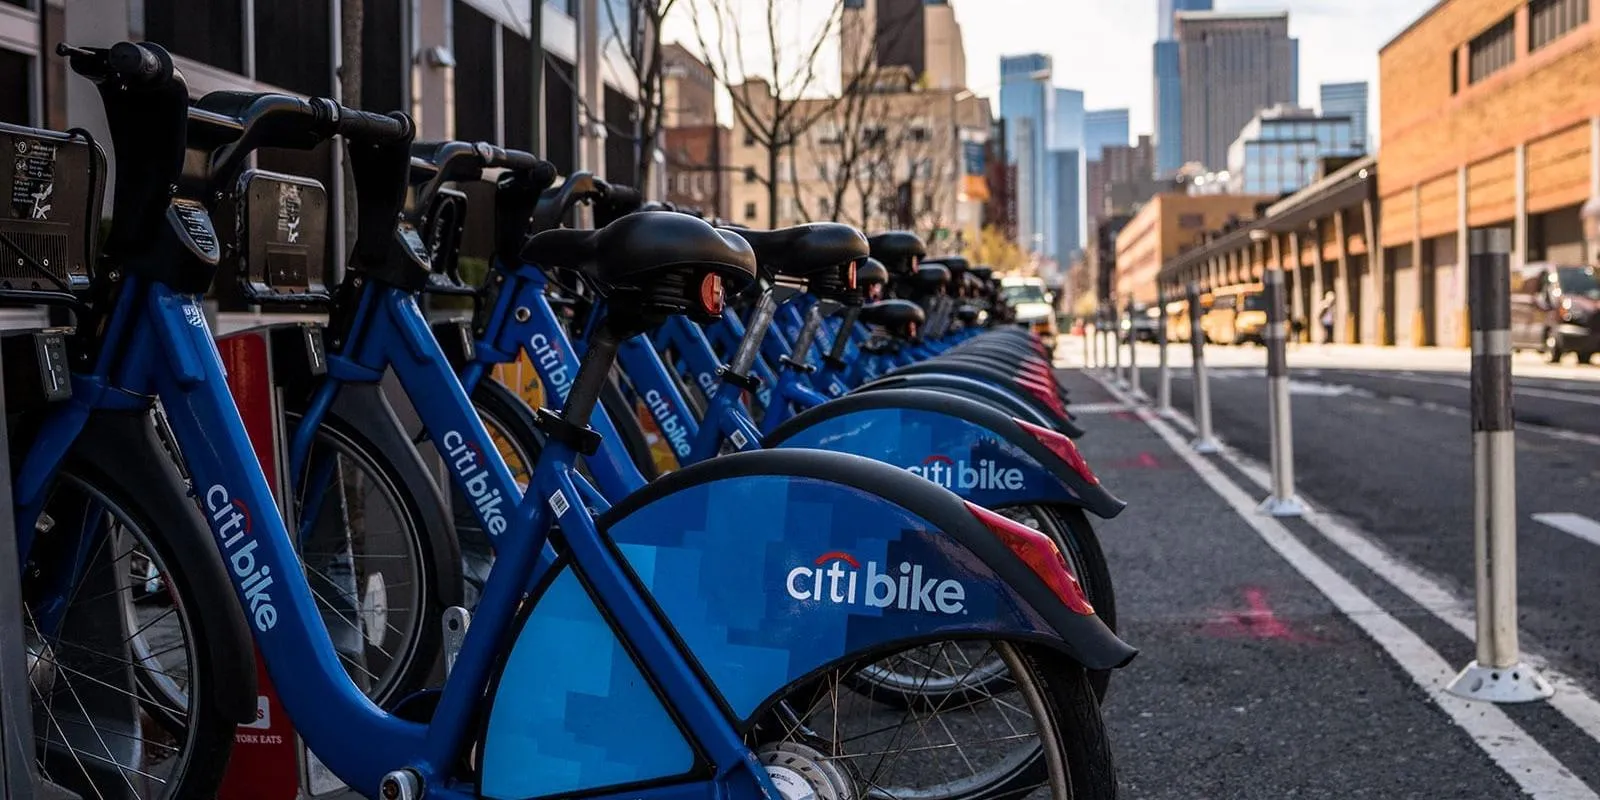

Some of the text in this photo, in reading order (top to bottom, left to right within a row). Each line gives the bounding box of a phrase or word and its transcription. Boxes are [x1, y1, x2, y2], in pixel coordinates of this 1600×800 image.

[529, 333, 560, 370] citi
[646, 389, 692, 458] citi bike
[443, 430, 507, 536] citi bike
[958, 459, 1025, 490] bike
[206, 484, 278, 632] citi bike
[786, 551, 967, 615] citi bike
